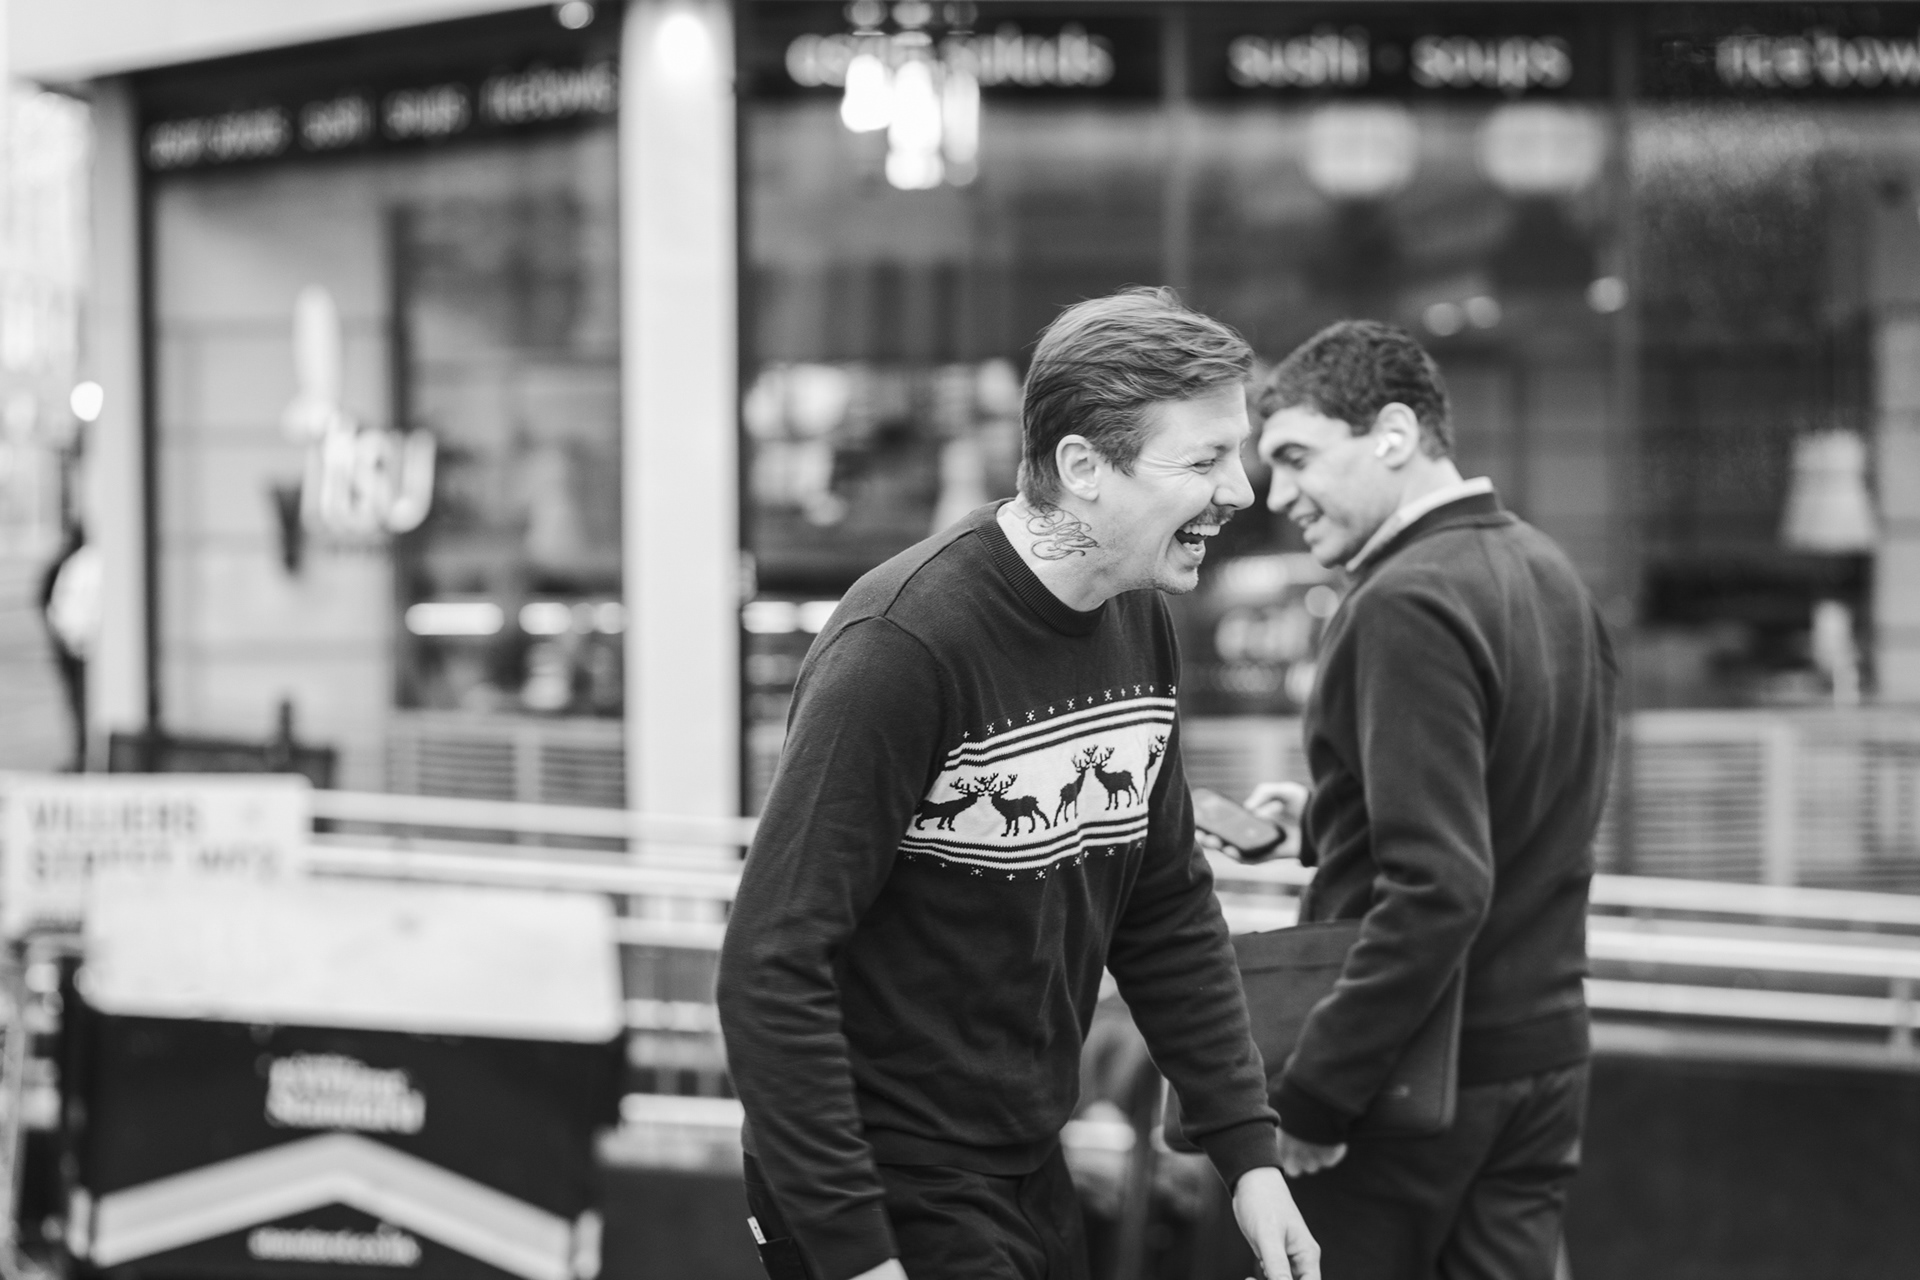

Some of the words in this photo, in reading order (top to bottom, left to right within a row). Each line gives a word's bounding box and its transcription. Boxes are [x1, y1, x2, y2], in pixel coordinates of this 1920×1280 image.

[1230, 28, 1370, 87] sushi
[1411, 34, 1572, 95] soups
[28, 799, 201, 836] VILLIERS
